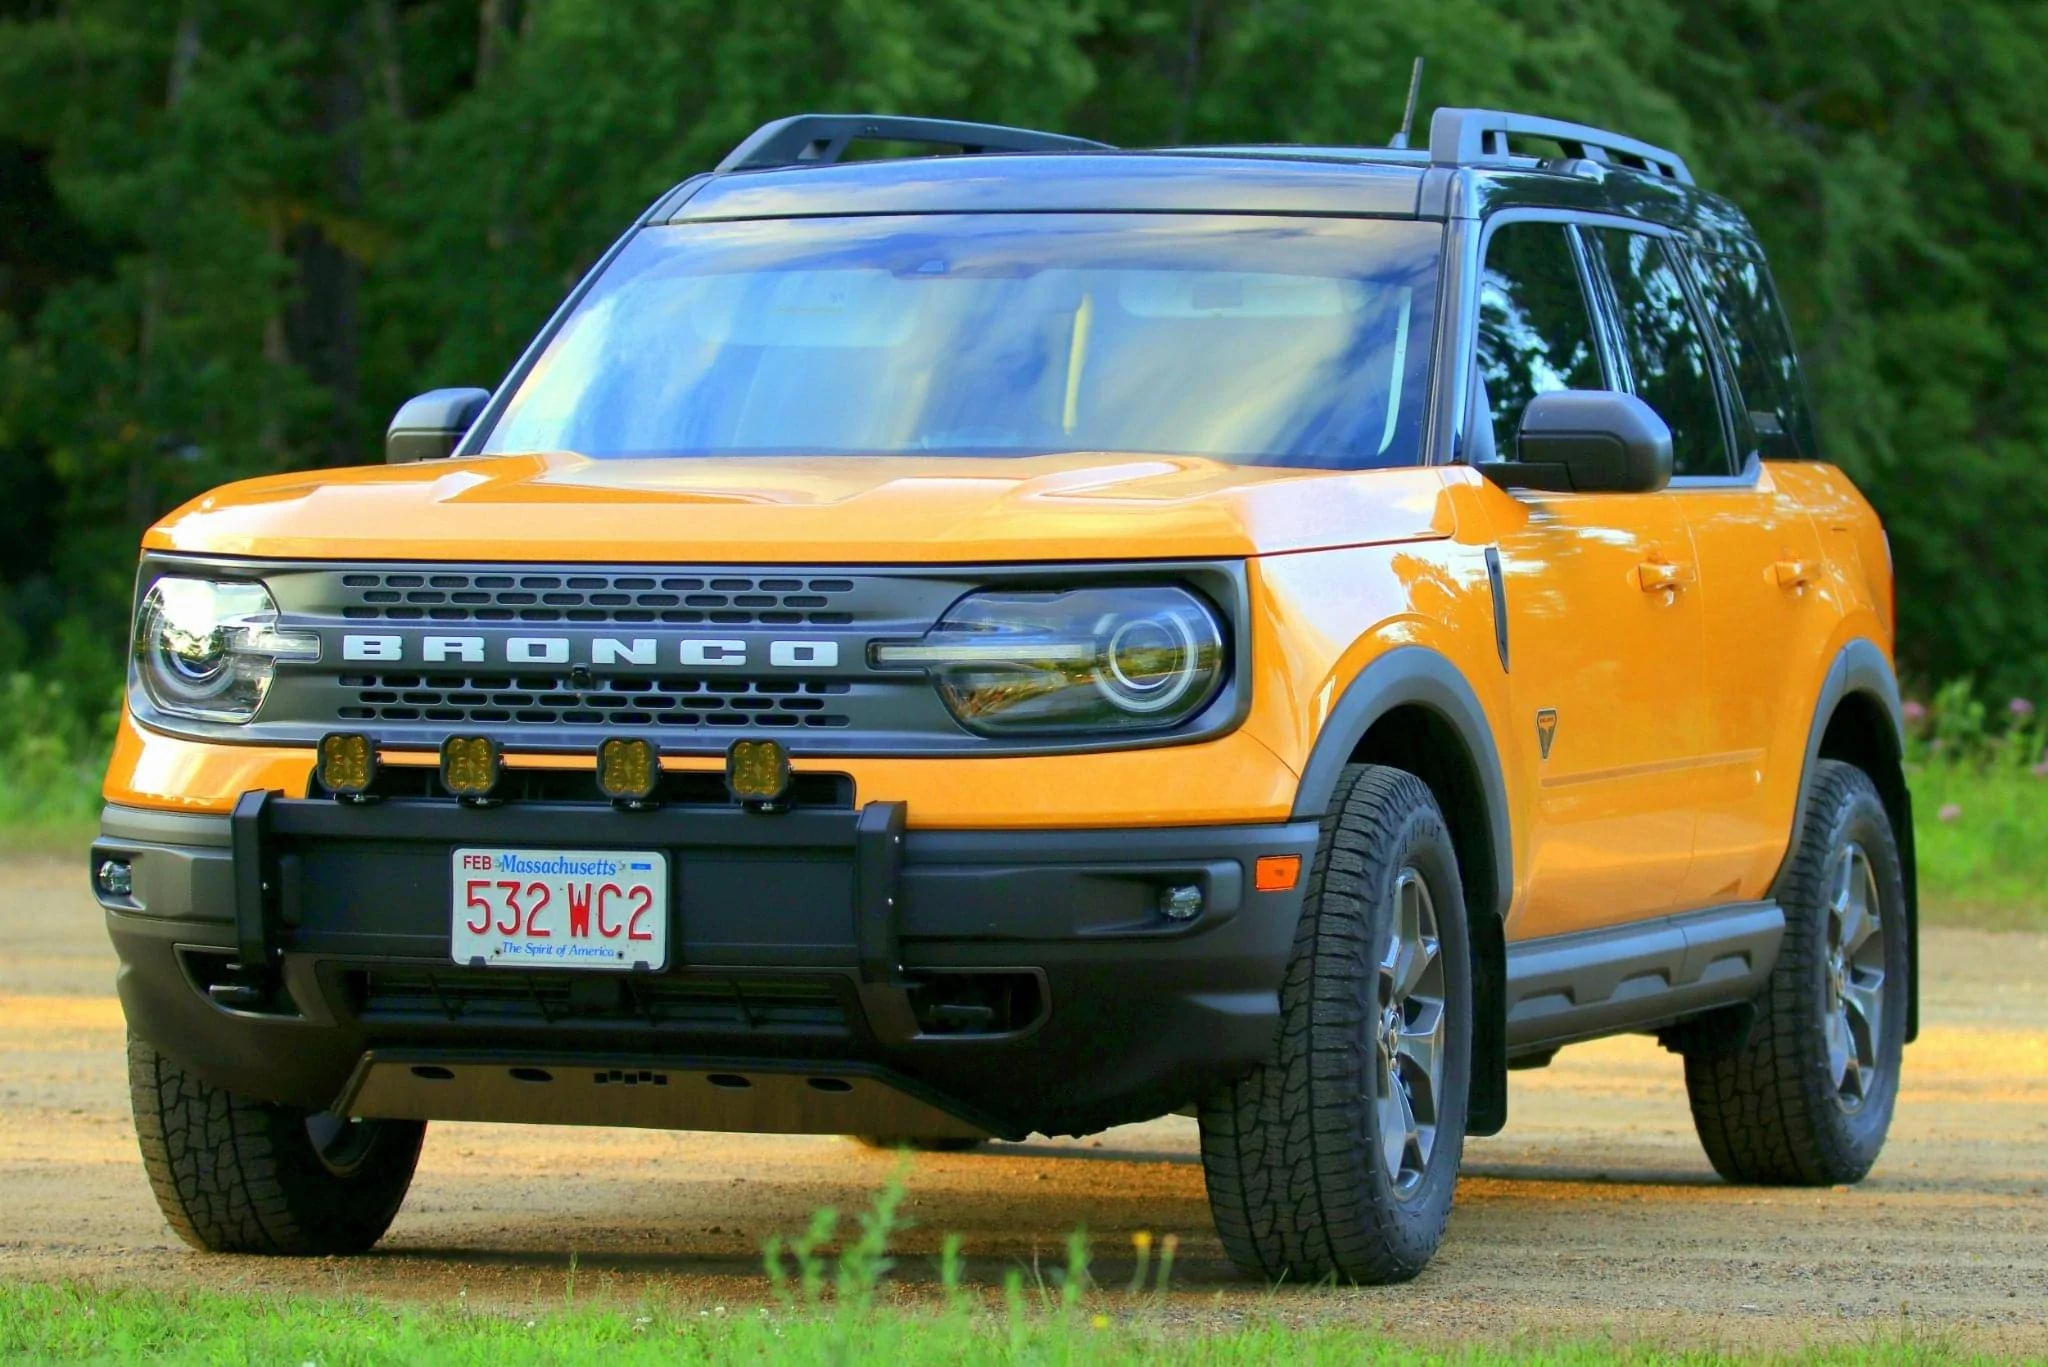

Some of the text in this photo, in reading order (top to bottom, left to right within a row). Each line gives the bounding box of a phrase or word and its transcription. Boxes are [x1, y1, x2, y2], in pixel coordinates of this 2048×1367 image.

[343, 634, 839, 667] BRONCO
[463, 854, 617, 876] FEB Massachusetts
[466, 880, 653, 941] 532 WC2
[502, 942, 614, 958] The Spirit of America
